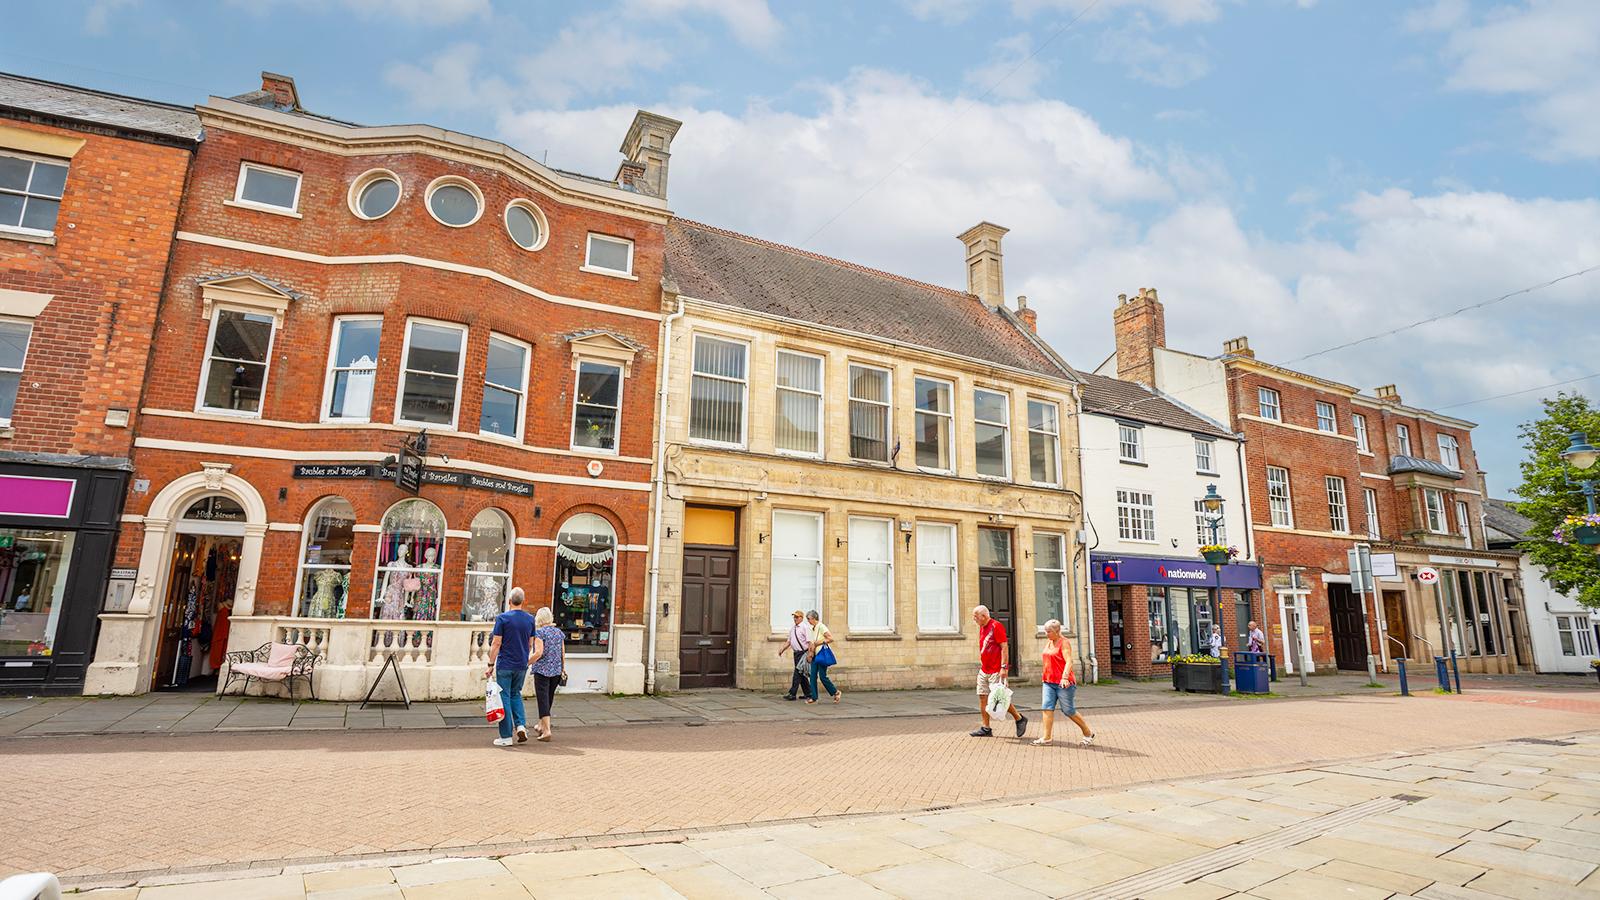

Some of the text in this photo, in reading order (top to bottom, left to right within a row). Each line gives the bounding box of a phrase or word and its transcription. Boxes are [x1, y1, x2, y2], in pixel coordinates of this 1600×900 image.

[300, 467, 366, 477] Baubles and Bangles
[429, 472, 457, 482] Bangles
[471, 476, 494, 487] Baubles
[507, 482, 528, 493] Bangles
[215, 501, 221, 509] 5
[196, 510, 213, 520] High
[1168, 568, 1207, 579] nationwide
